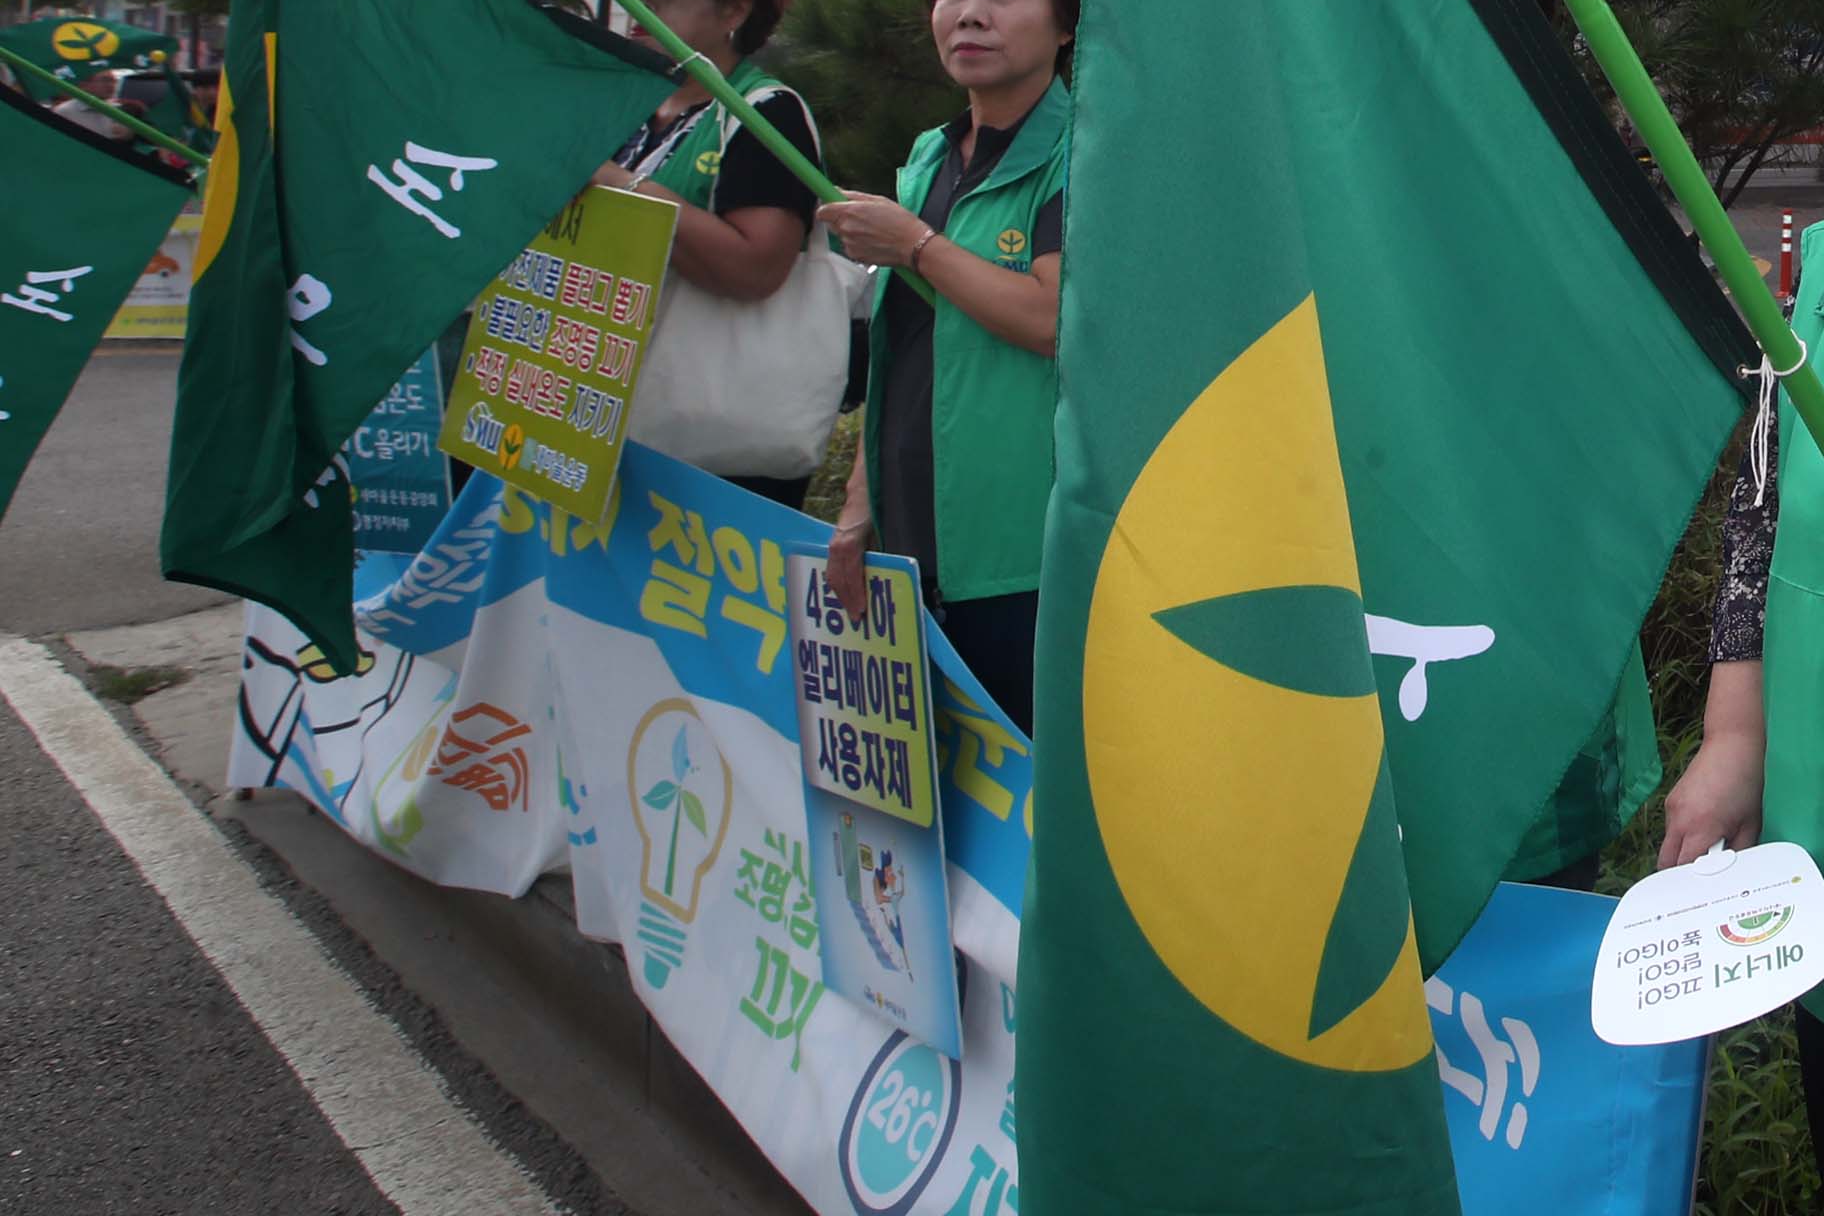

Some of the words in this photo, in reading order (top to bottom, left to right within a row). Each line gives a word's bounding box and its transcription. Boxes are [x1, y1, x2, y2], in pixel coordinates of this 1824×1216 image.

[487, 294, 551, 353] 불필요한
[547, 315, 600, 373] 조명등
[597, 334, 638, 387] 끄기
[560, 262, 614, 316] 플러그
[612, 277, 652, 330] 뽑기
[462, 402, 506, 456] SMU
[474, 345, 509, 396] 적정
[505, 359, 572, 421] 실내온도
[568, 384, 624, 446] 지키기
[374, 428, 430, 460] 올리기
[640, 490, 787, 676] 절약
[798, 637, 918, 732] 엘리베이터
[818, 716, 914, 811] 사용자제
[1715, 943, 1804, 988] 에너지
